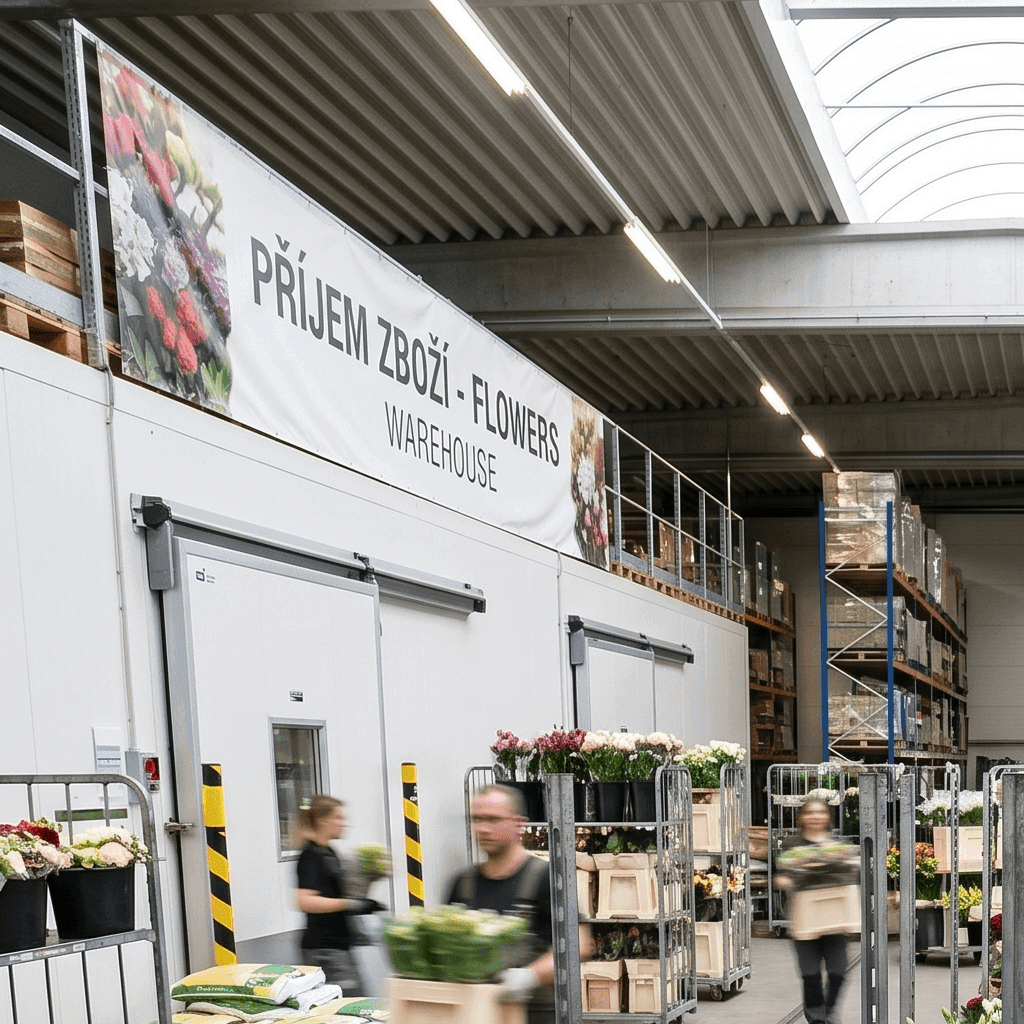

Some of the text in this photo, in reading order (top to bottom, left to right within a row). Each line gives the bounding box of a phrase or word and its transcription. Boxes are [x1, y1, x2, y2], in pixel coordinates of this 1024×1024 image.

[250, 233, 369, 366] PŘÍJEM
[377, 315, 450, 409] ZBOŽÍ
[472, 373, 560, 467] FLOWERS
[385, 401, 497, 493] WAREHOUSE
